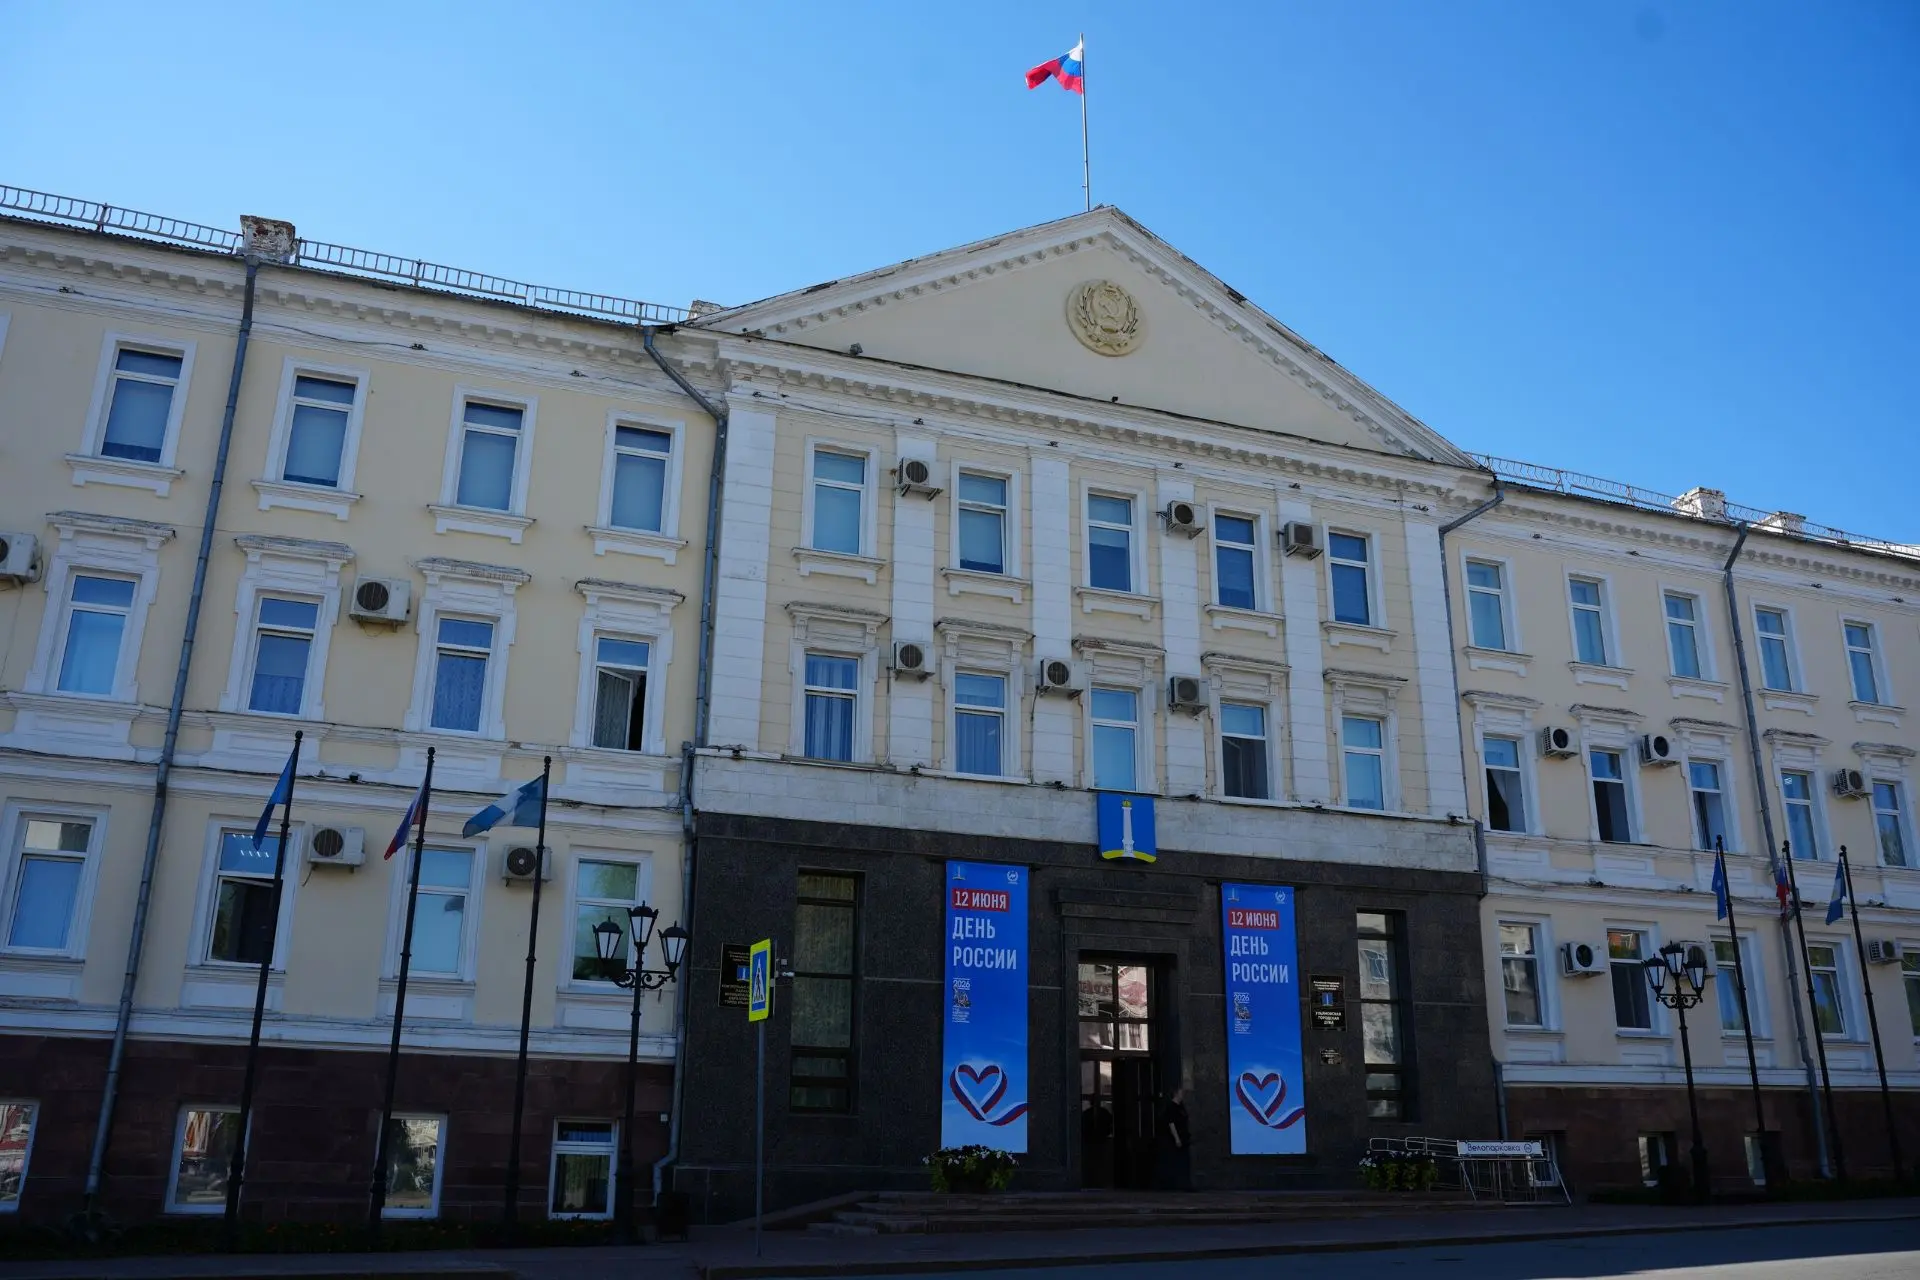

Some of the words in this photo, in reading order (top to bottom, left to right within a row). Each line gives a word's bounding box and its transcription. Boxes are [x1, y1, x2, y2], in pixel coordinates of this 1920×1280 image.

[955, 891, 969, 907] 12
[972, 892, 1007, 909] ИЮНЯ
[952, 916, 996, 940] ДЕНЬ
[1231, 911, 1244, 926] 12
[1246, 912, 1277, 927] ИЮНЯ
[1230, 935, 1269, 957] ДЕНЬ
[953, 946, 1017, 970] РОССИИ
[1232, 962, 1289, 984] РОССИИ
[953, 979, 970, 988] 2026
[1467, 1143, 1521, 1152] Велопарковка
